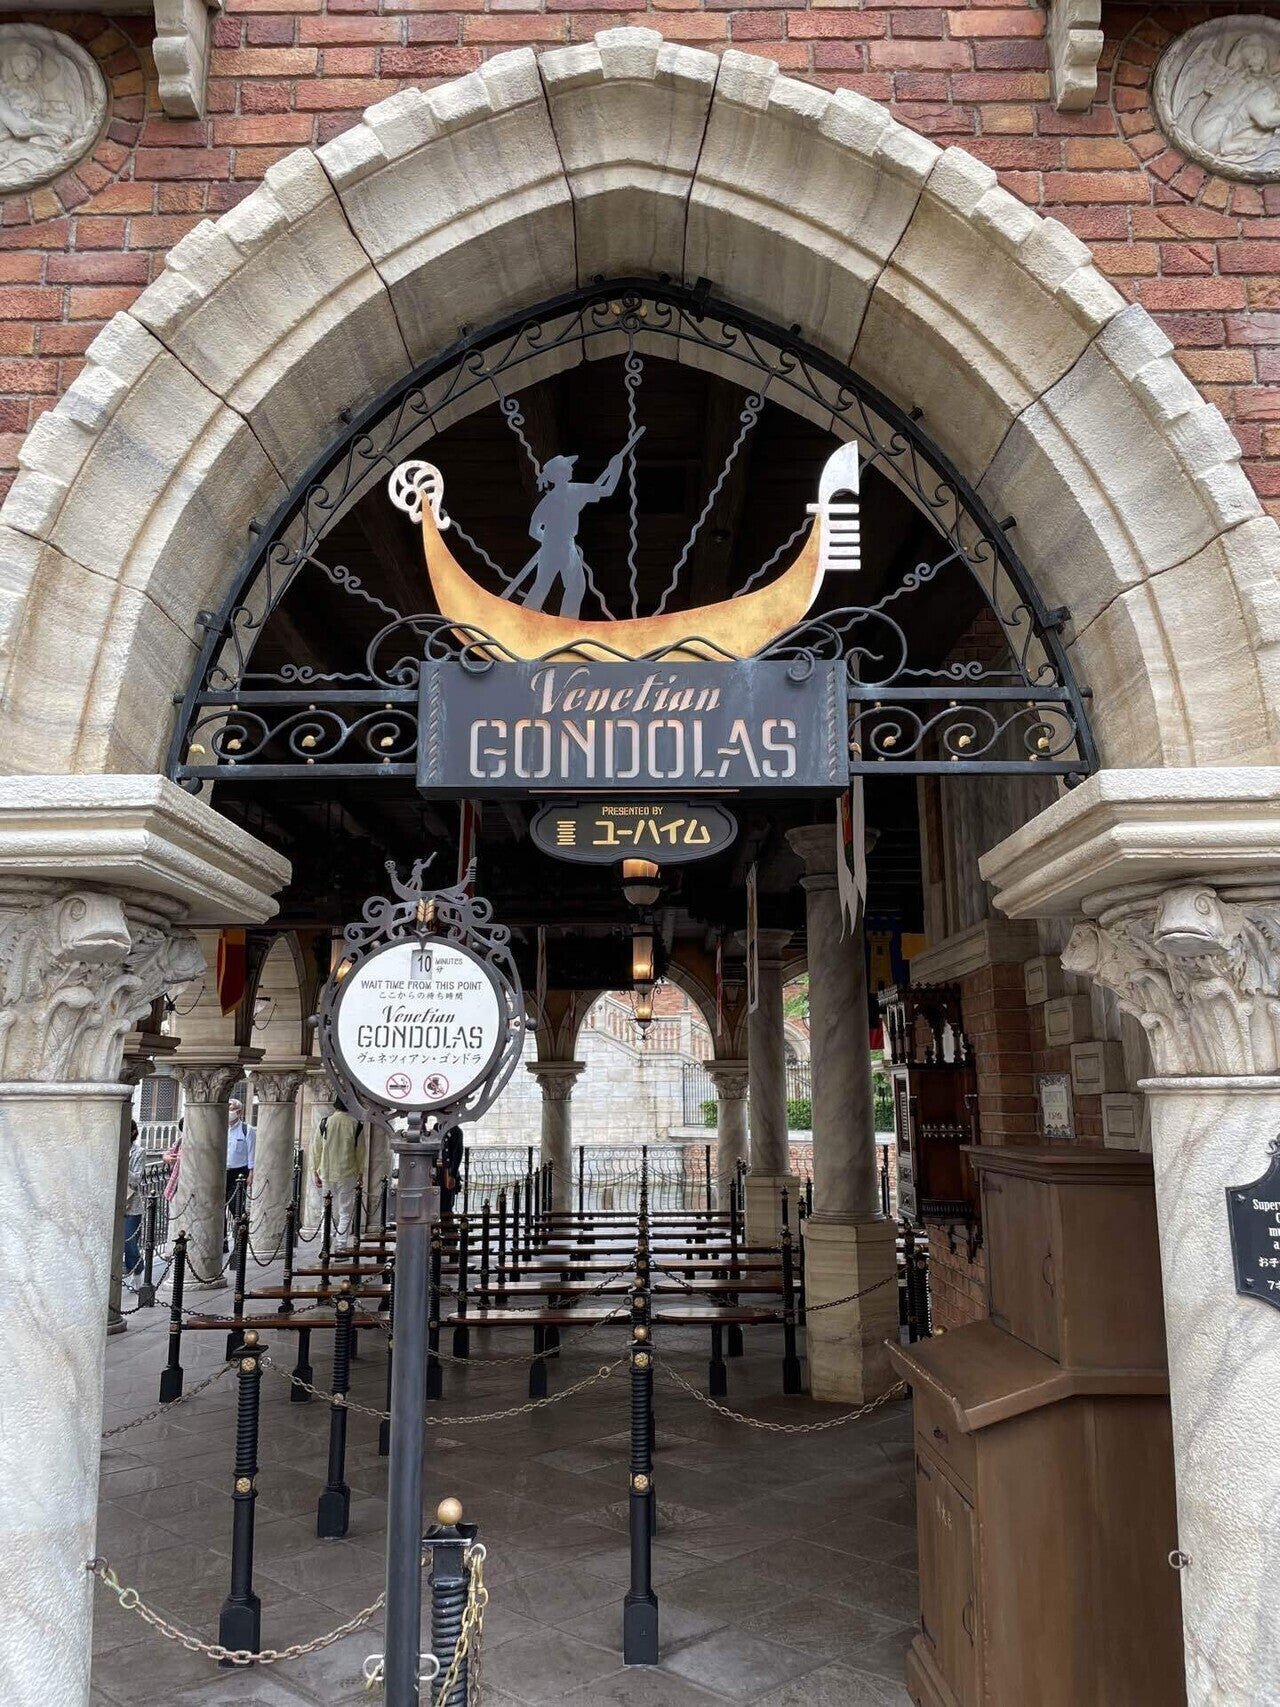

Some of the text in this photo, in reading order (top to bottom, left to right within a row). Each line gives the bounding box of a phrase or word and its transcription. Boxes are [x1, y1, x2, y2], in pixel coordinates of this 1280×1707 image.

[530, 664, 723, 714] Venetian
[468, 718, 798, 779] GONDOLAS
[602, 806, 664, 816] PRESENTED BY
[592, 819, 711, 845] ユーハイム
[417, 955, 463, 973] 10 MINUTES
[435, 966, 444, 974] 分
[361, 980, 483, 990] WAIT TIME FROM THIS POINT
[379, 991, 464, 1001] ここからの待ち時間
[382, 1004, 456, 1024] Venetian
[357, 1025, 483, 1049] GONDOLAS
[357, 1051, 482, 1065] ヴェネツィアン・ゴンドラ
